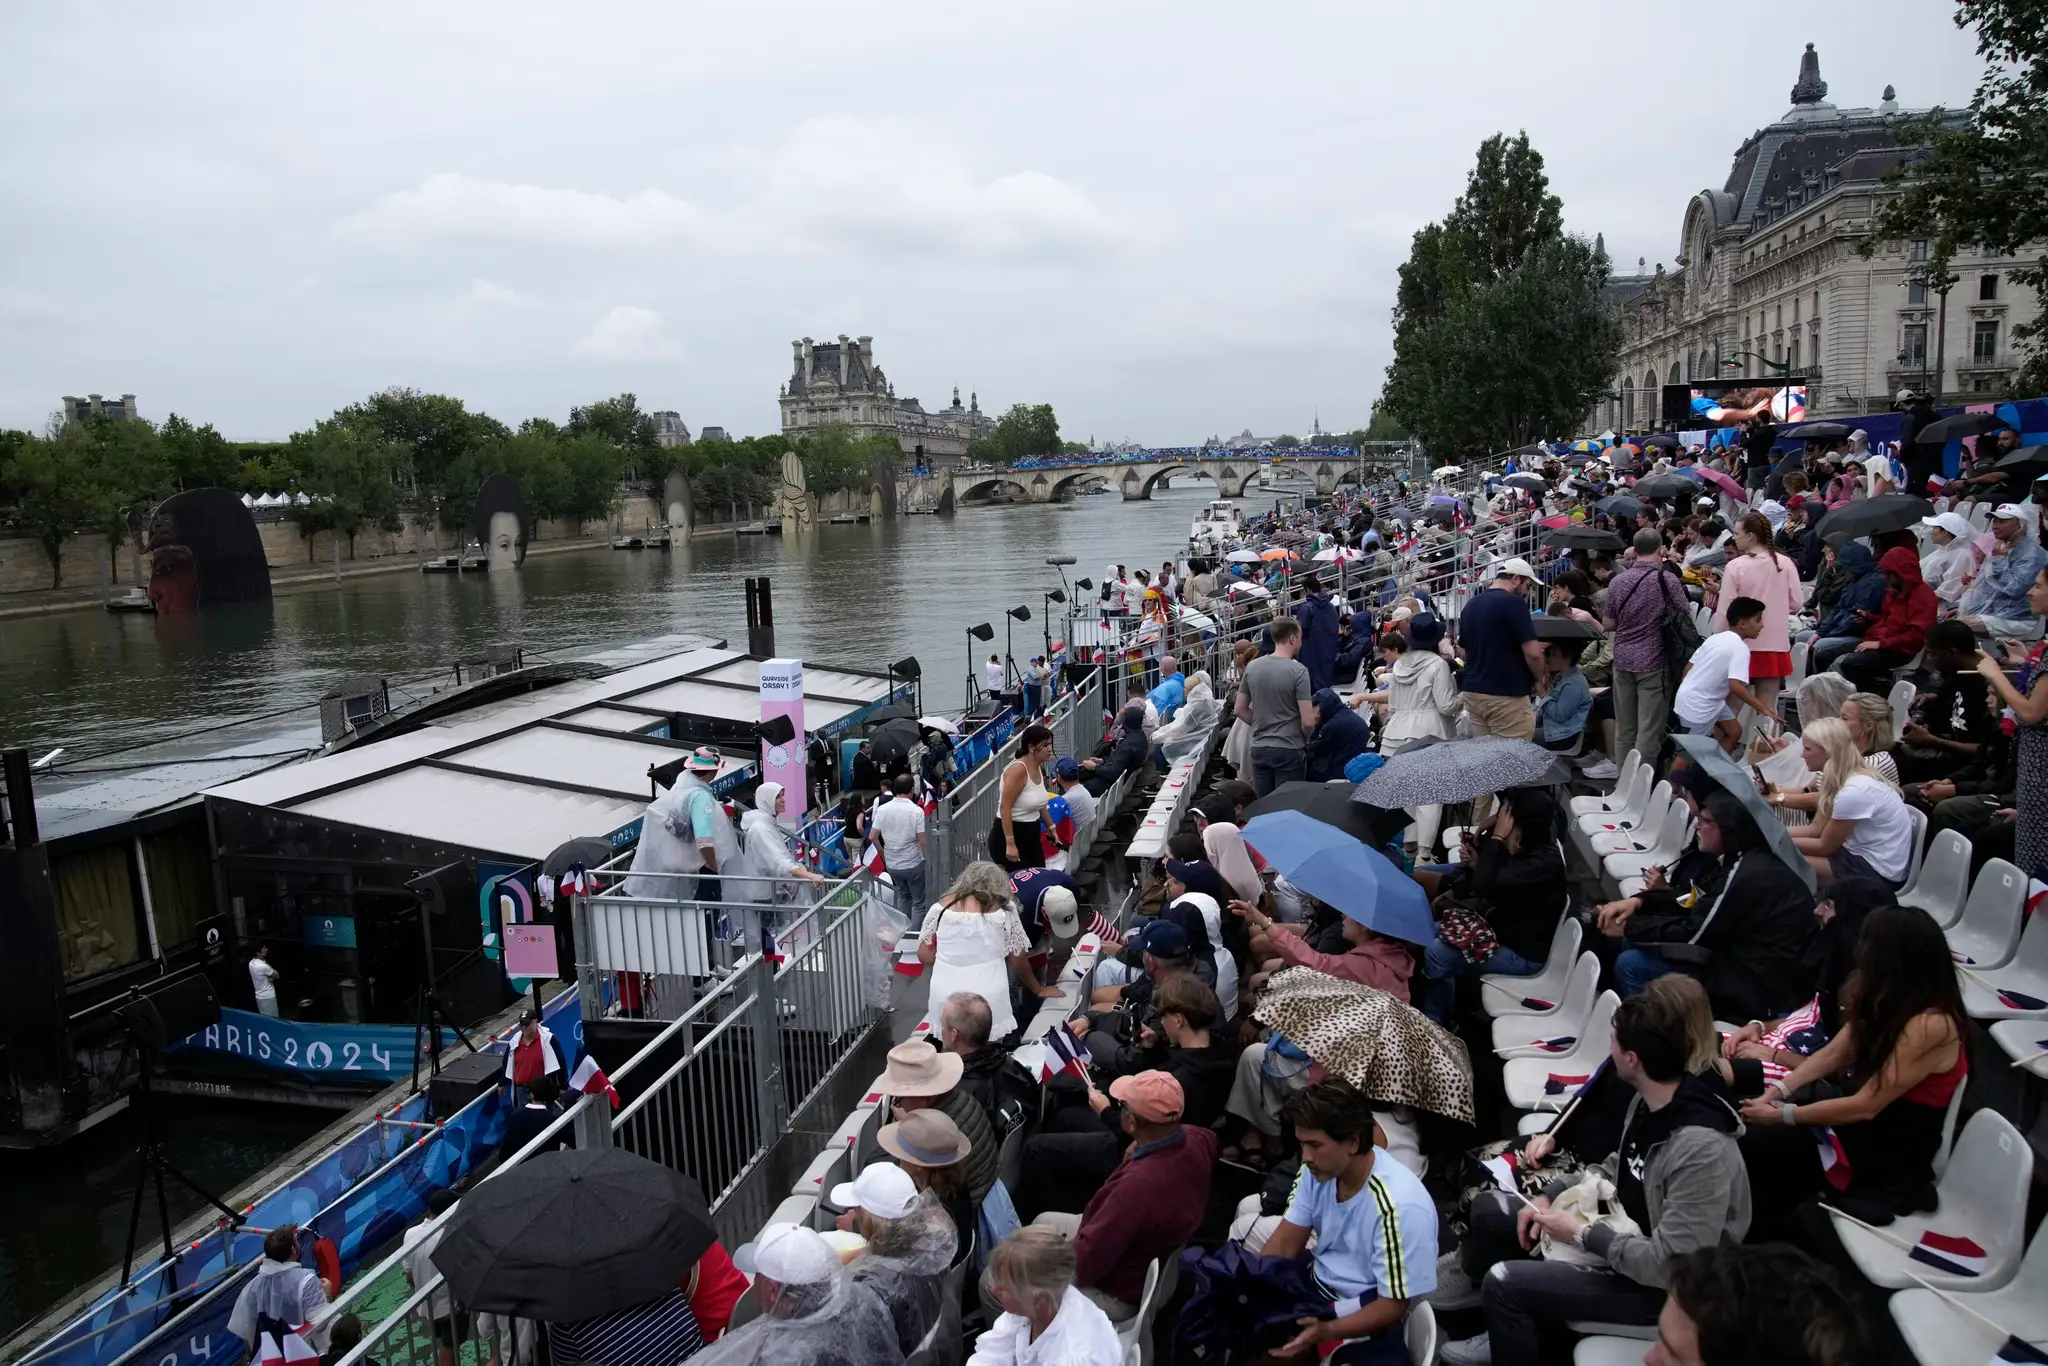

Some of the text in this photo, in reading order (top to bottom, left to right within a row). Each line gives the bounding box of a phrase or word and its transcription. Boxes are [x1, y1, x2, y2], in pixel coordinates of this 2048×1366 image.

[718, 777, 736, 792] 2024
[612, 827, 634, 847] 2024
[284, 1037, 390, 1072] 2024
